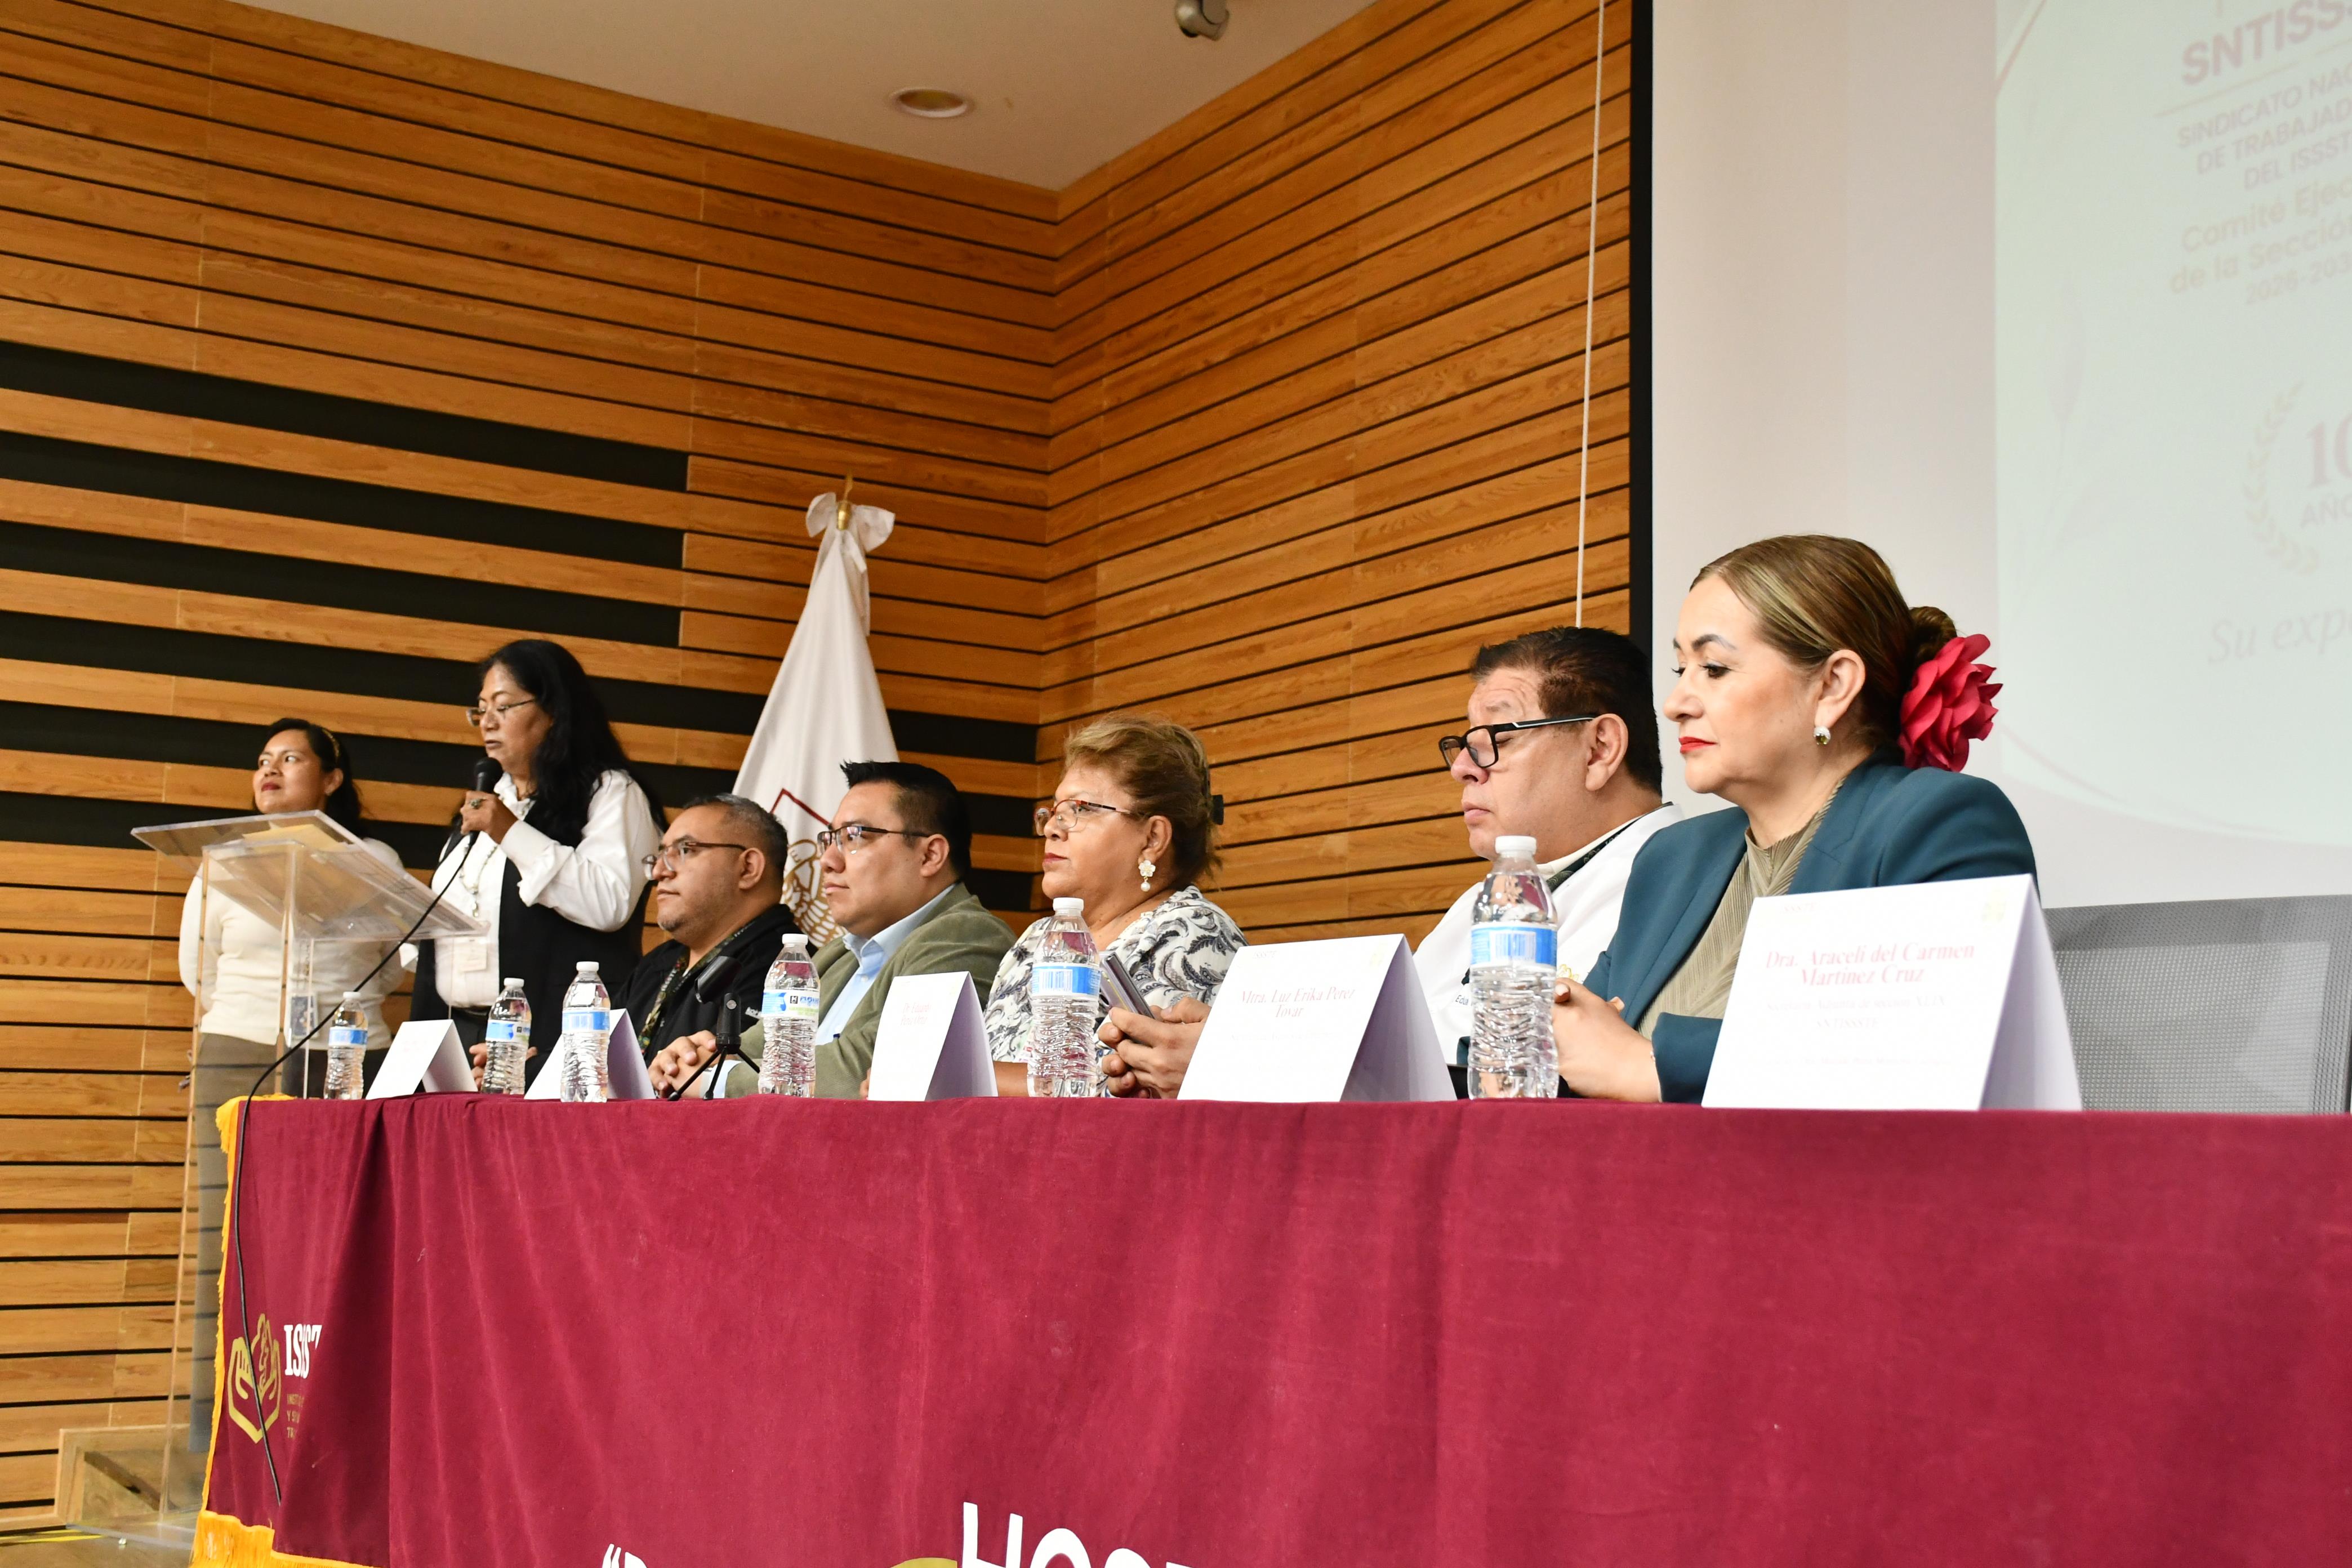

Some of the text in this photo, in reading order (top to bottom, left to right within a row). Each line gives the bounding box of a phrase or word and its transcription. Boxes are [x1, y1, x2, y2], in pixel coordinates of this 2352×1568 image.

[2181, 0, 2352, 85] SNTISS
[2176, 85, 2302, 148] SINDICATO
[2197, 145, 2226, 175] DE
[2244, 160, 2283, 191] DEL
[2170, 265, 2208, 295] de
[2213, 255, 2241, 280] la
[2207, 608, 2352, 665] Su exp
[1766, 942, 1975, 969] Dra. Araceli del Carmen
[1881, 964, 1925, 983] Cruz
[1242, 990, 1267, 1004] Mtra.
[1271, 989, 1291, 1003] Luz
[1294, 987, 1324, 1002] Erika
[1275, 1004, 1304, 1018] Tovar
